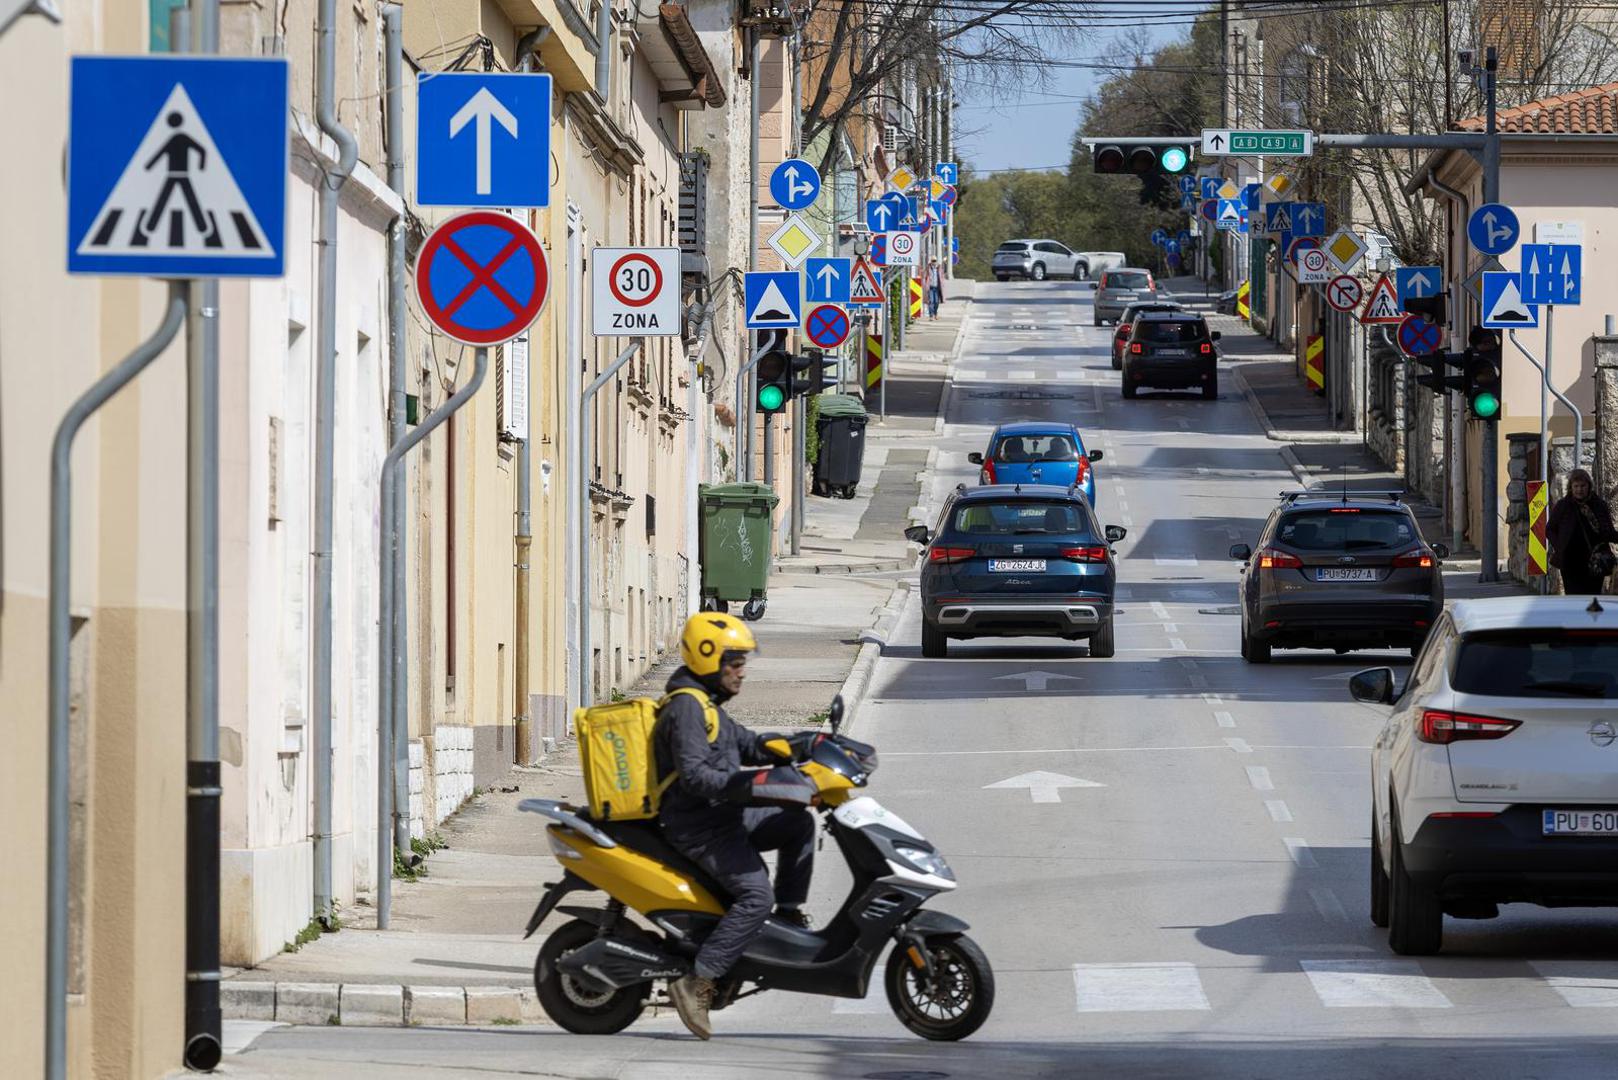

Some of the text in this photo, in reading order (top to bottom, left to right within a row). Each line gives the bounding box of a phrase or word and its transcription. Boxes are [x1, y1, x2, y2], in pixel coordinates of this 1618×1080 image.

[897, 239, 909, 249] 30
[1309, 256, 1321, 266] 30
[622, 268, 650, 292] 30
[1304, 273, 1324, 281] ZONA
[612, 313, 660, 328] ZONA
[1324, 569, 1335, 578] PU
[1557, 813, 1618, 831] PU 60
